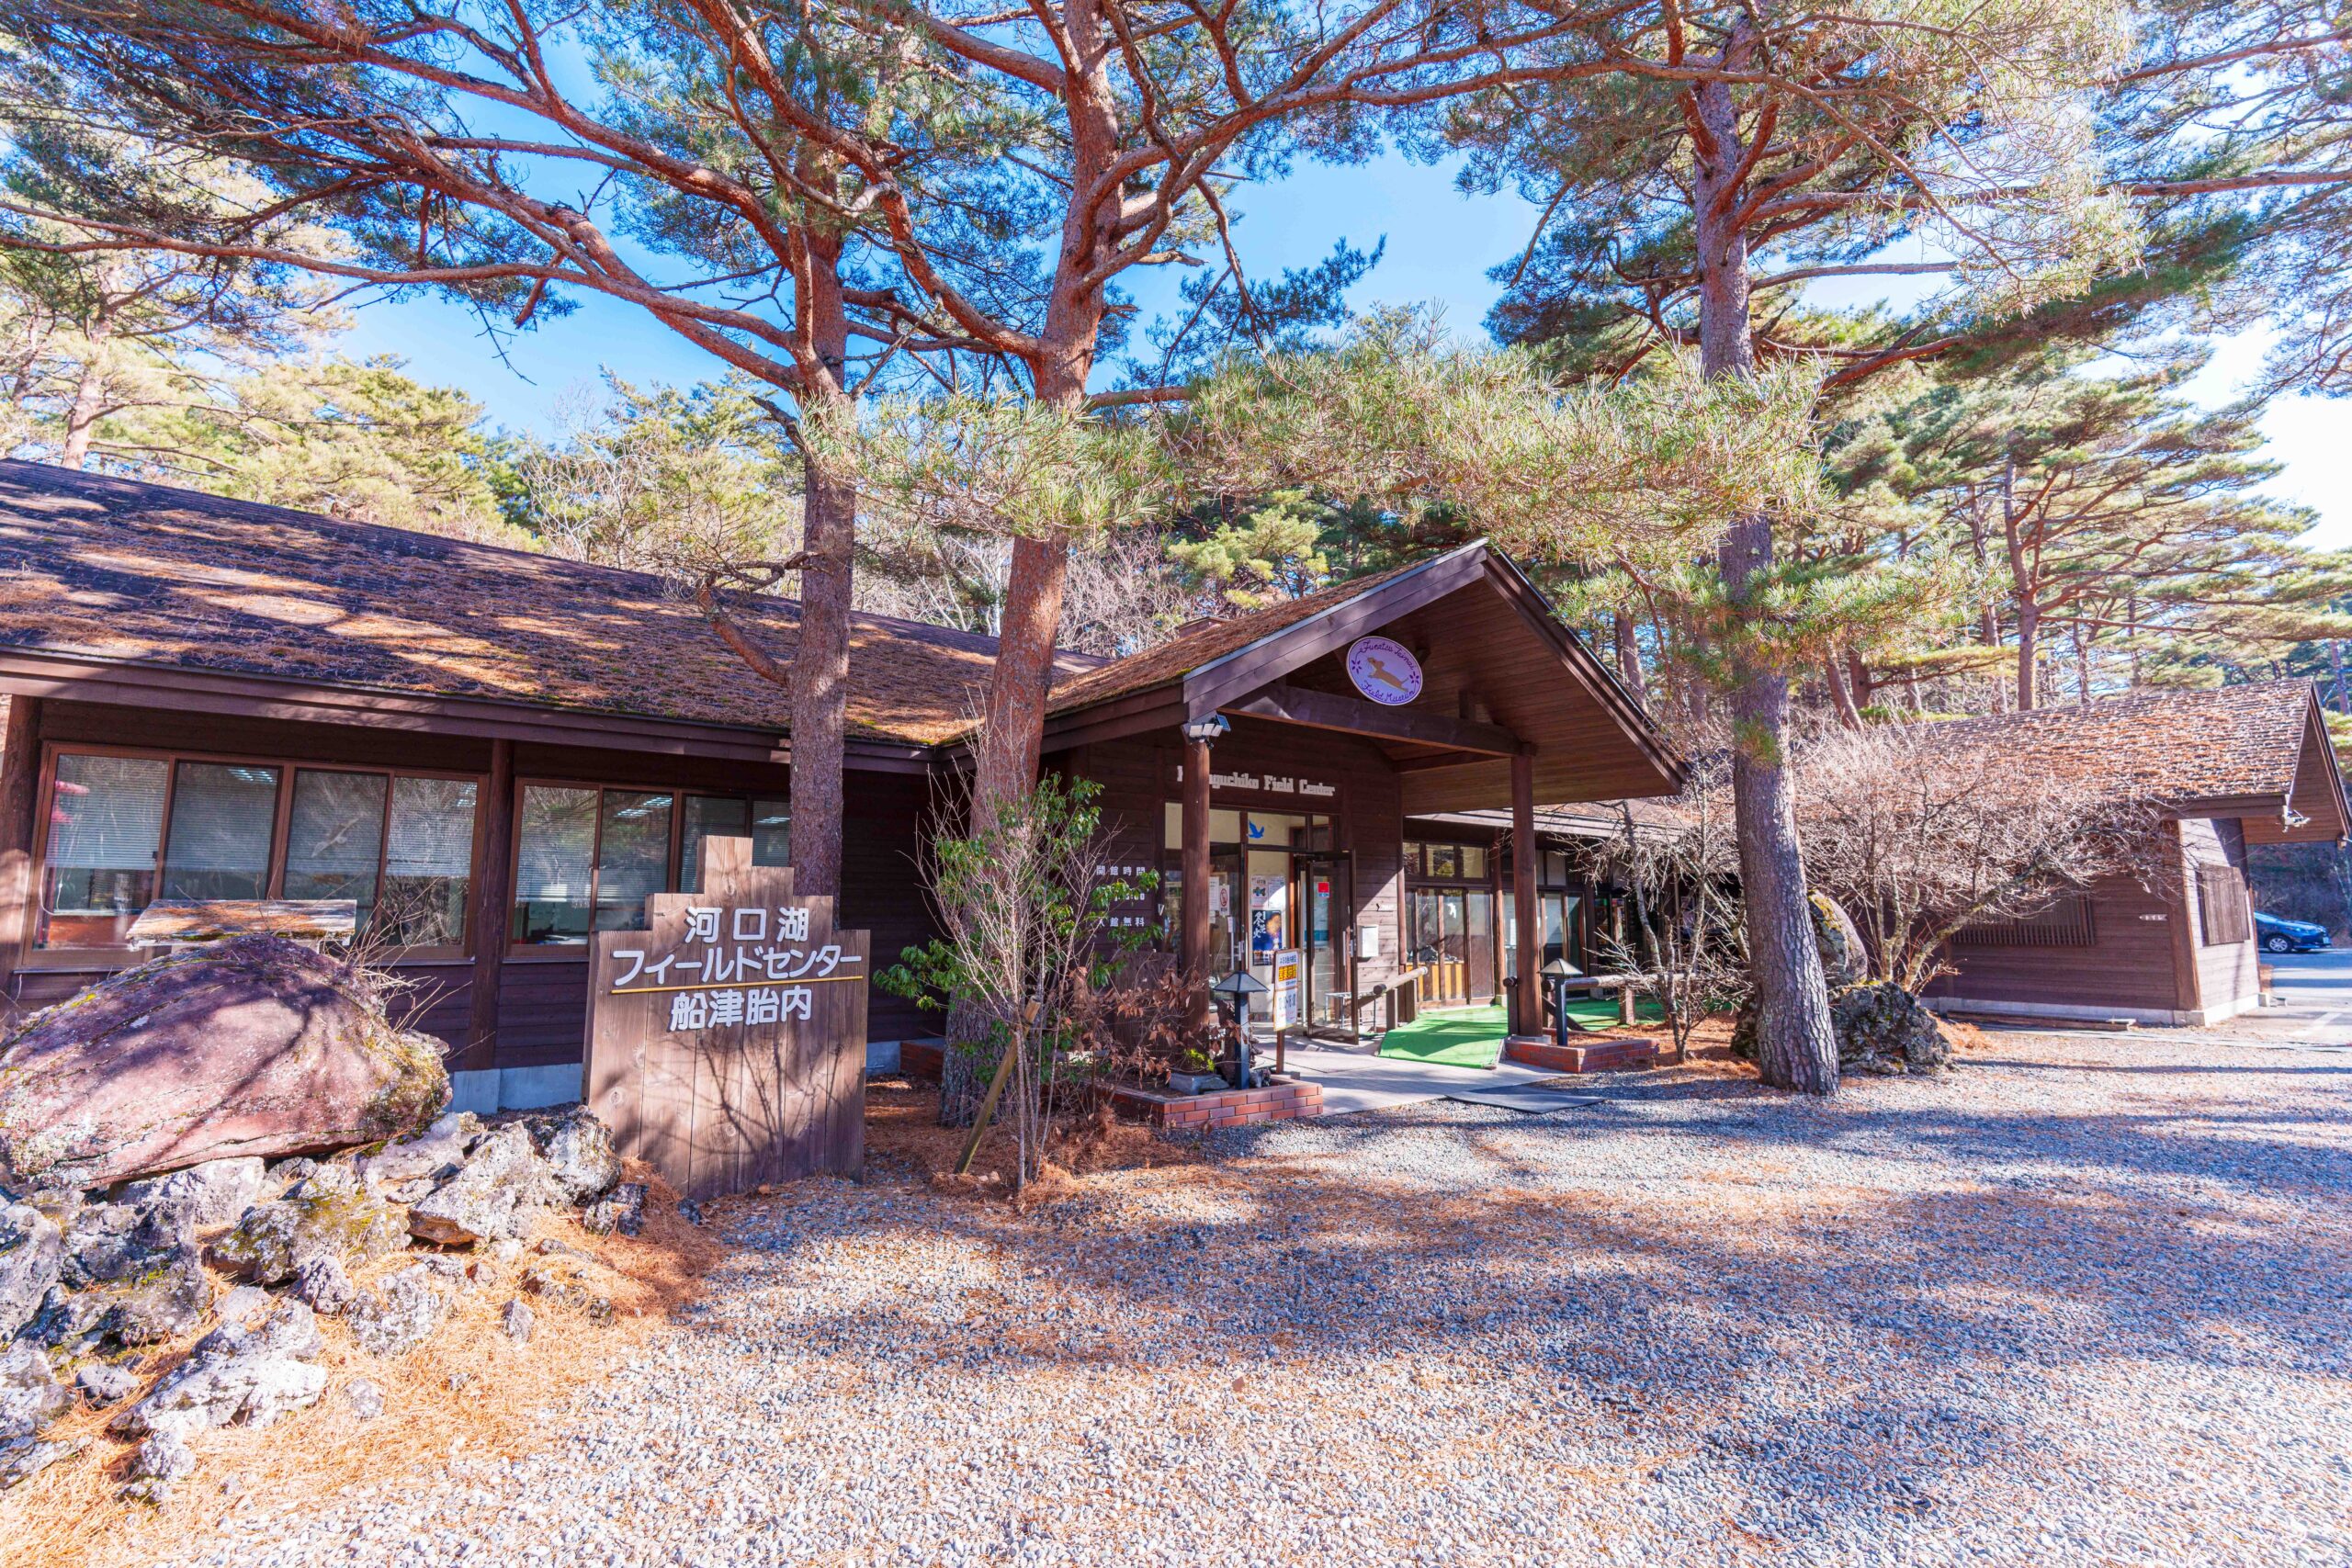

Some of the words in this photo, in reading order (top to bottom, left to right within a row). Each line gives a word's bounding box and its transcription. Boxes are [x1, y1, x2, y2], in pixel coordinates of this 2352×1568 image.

[1362, 680, 1384, 700] Field
[1263, 774, 1294, 793] Field
[1299, 779, 1335, 796] Center
[684, 907, 809, 943] 河口湖
[612, 945, 862, 987] フィールドセンター
[670, 985, 813, 1032] 船津胎内
